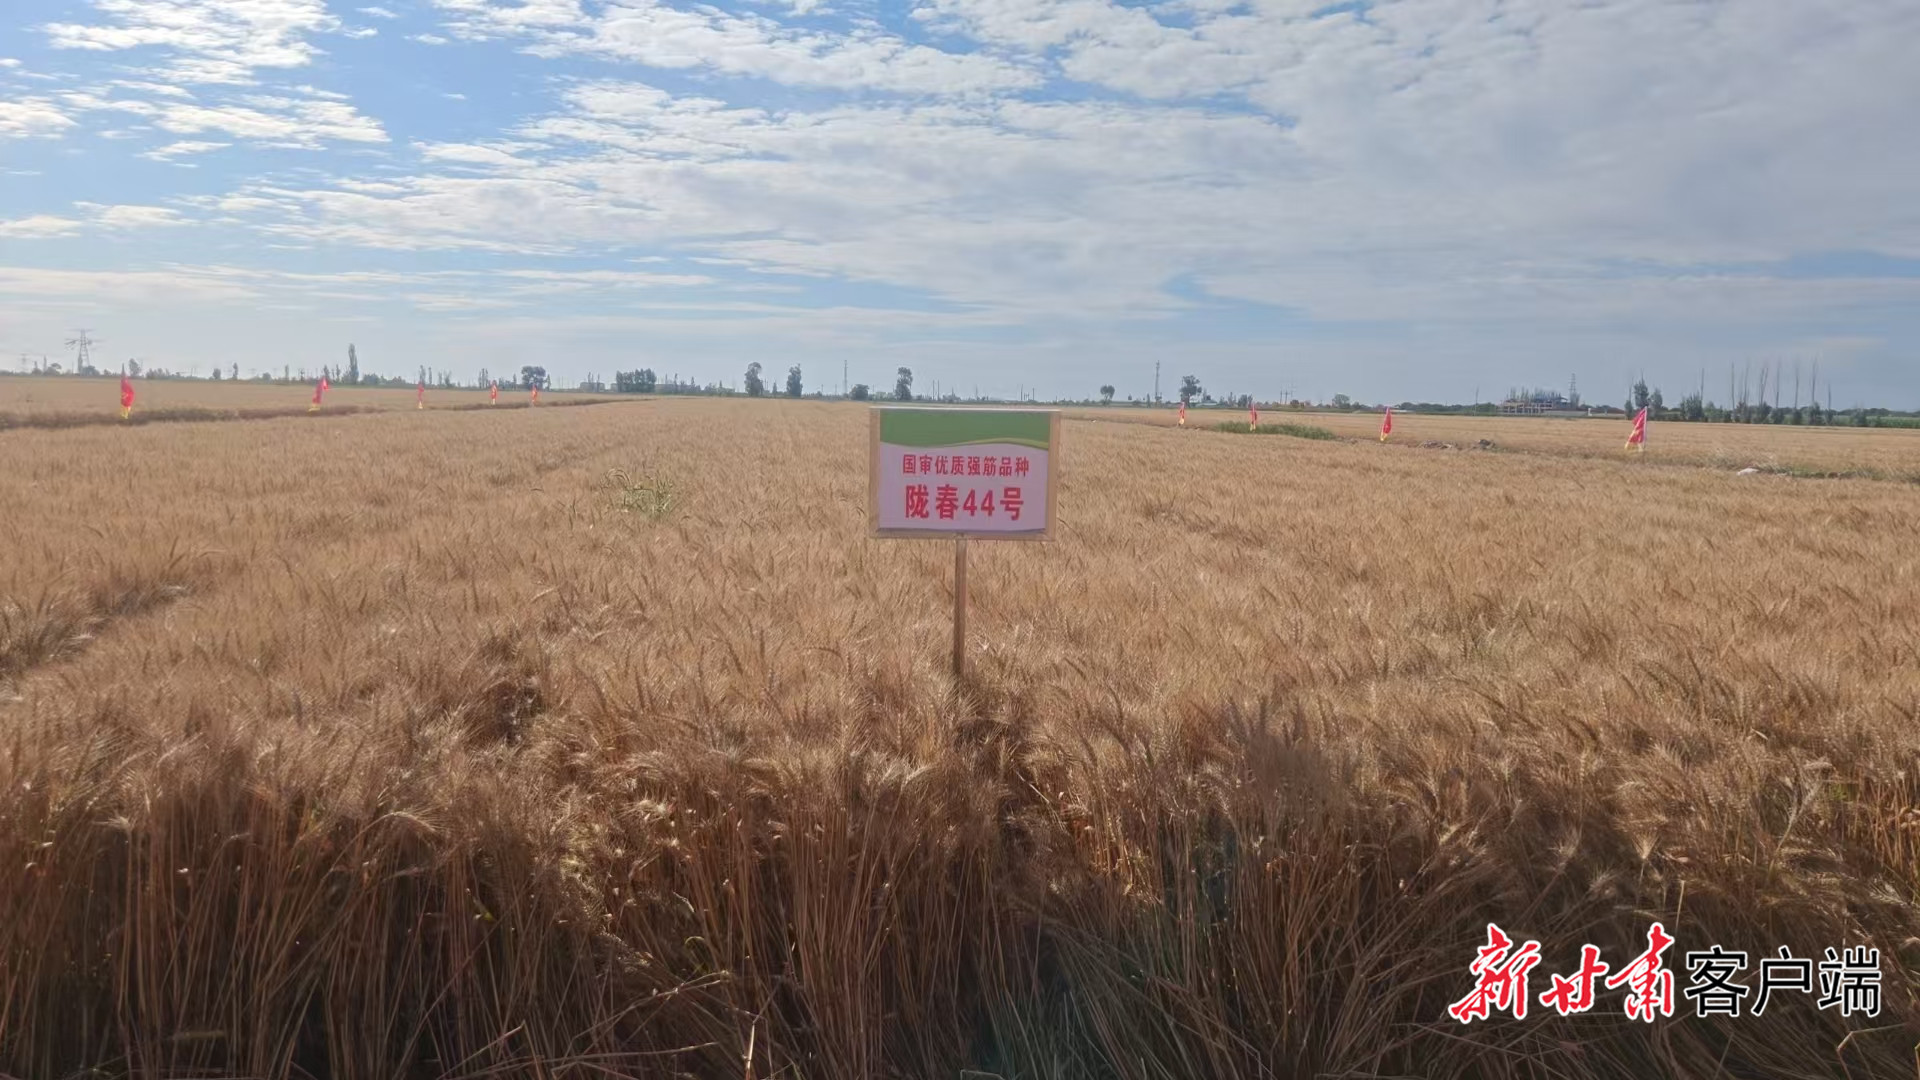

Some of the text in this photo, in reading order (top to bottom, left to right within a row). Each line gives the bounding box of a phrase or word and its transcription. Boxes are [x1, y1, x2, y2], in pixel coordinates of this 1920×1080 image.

[902, 454, 1029, 477] 国审优质强筋品种
[905, 484, 1024, 521] 陇春44号
